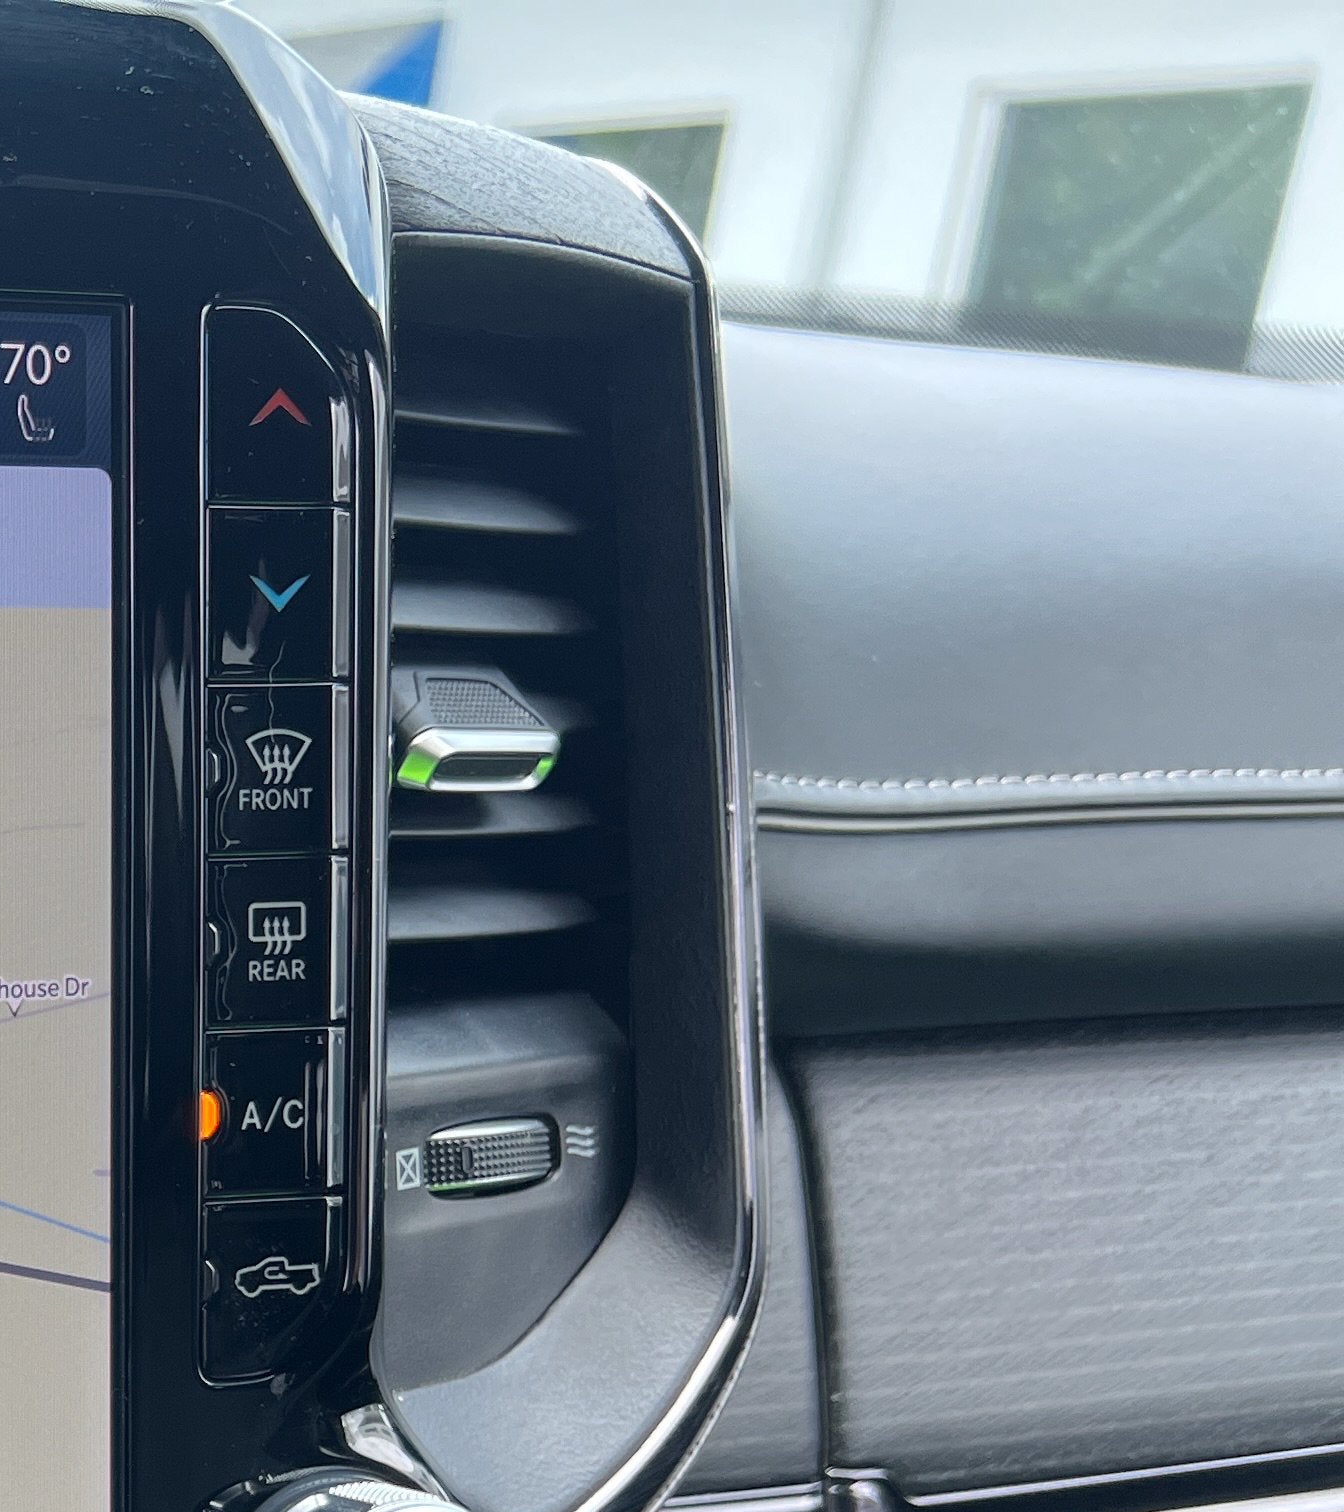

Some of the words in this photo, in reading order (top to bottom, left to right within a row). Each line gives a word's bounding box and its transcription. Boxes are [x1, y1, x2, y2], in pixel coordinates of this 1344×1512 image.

[0, 343, 71, 385] 70°
[238, 789, 312, 810] FRONT
[247, 960, 306, 982] REAR
[63, 976, 90, 998] Dr
[240, 1103, 305, 1132] A/C
